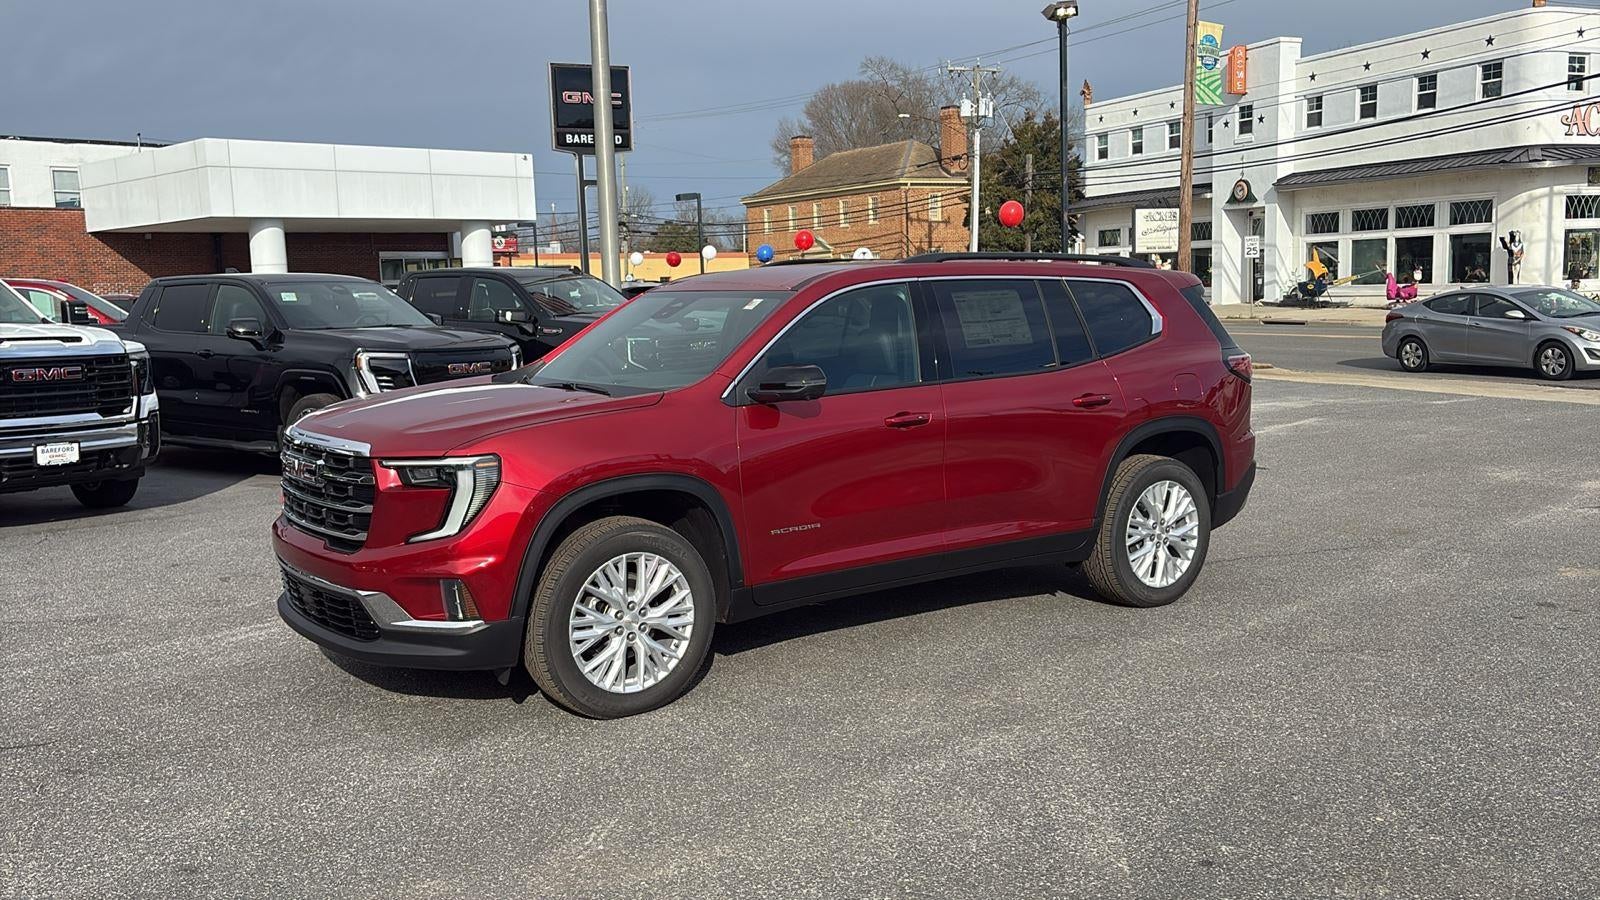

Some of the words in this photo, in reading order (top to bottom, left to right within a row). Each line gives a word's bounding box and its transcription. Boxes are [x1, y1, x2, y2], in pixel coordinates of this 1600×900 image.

[1560, 102, 1600, 137] AC
[565, 133, 623, 145] BARED
[1246, 246, 1258, 255] 25
[448, 361, 491, 374] GMC
[12, 367, 82, 381] GMC
[41, 446, 75, 455] BAREFORD
[770, 523, 821, 535] ACADIA
